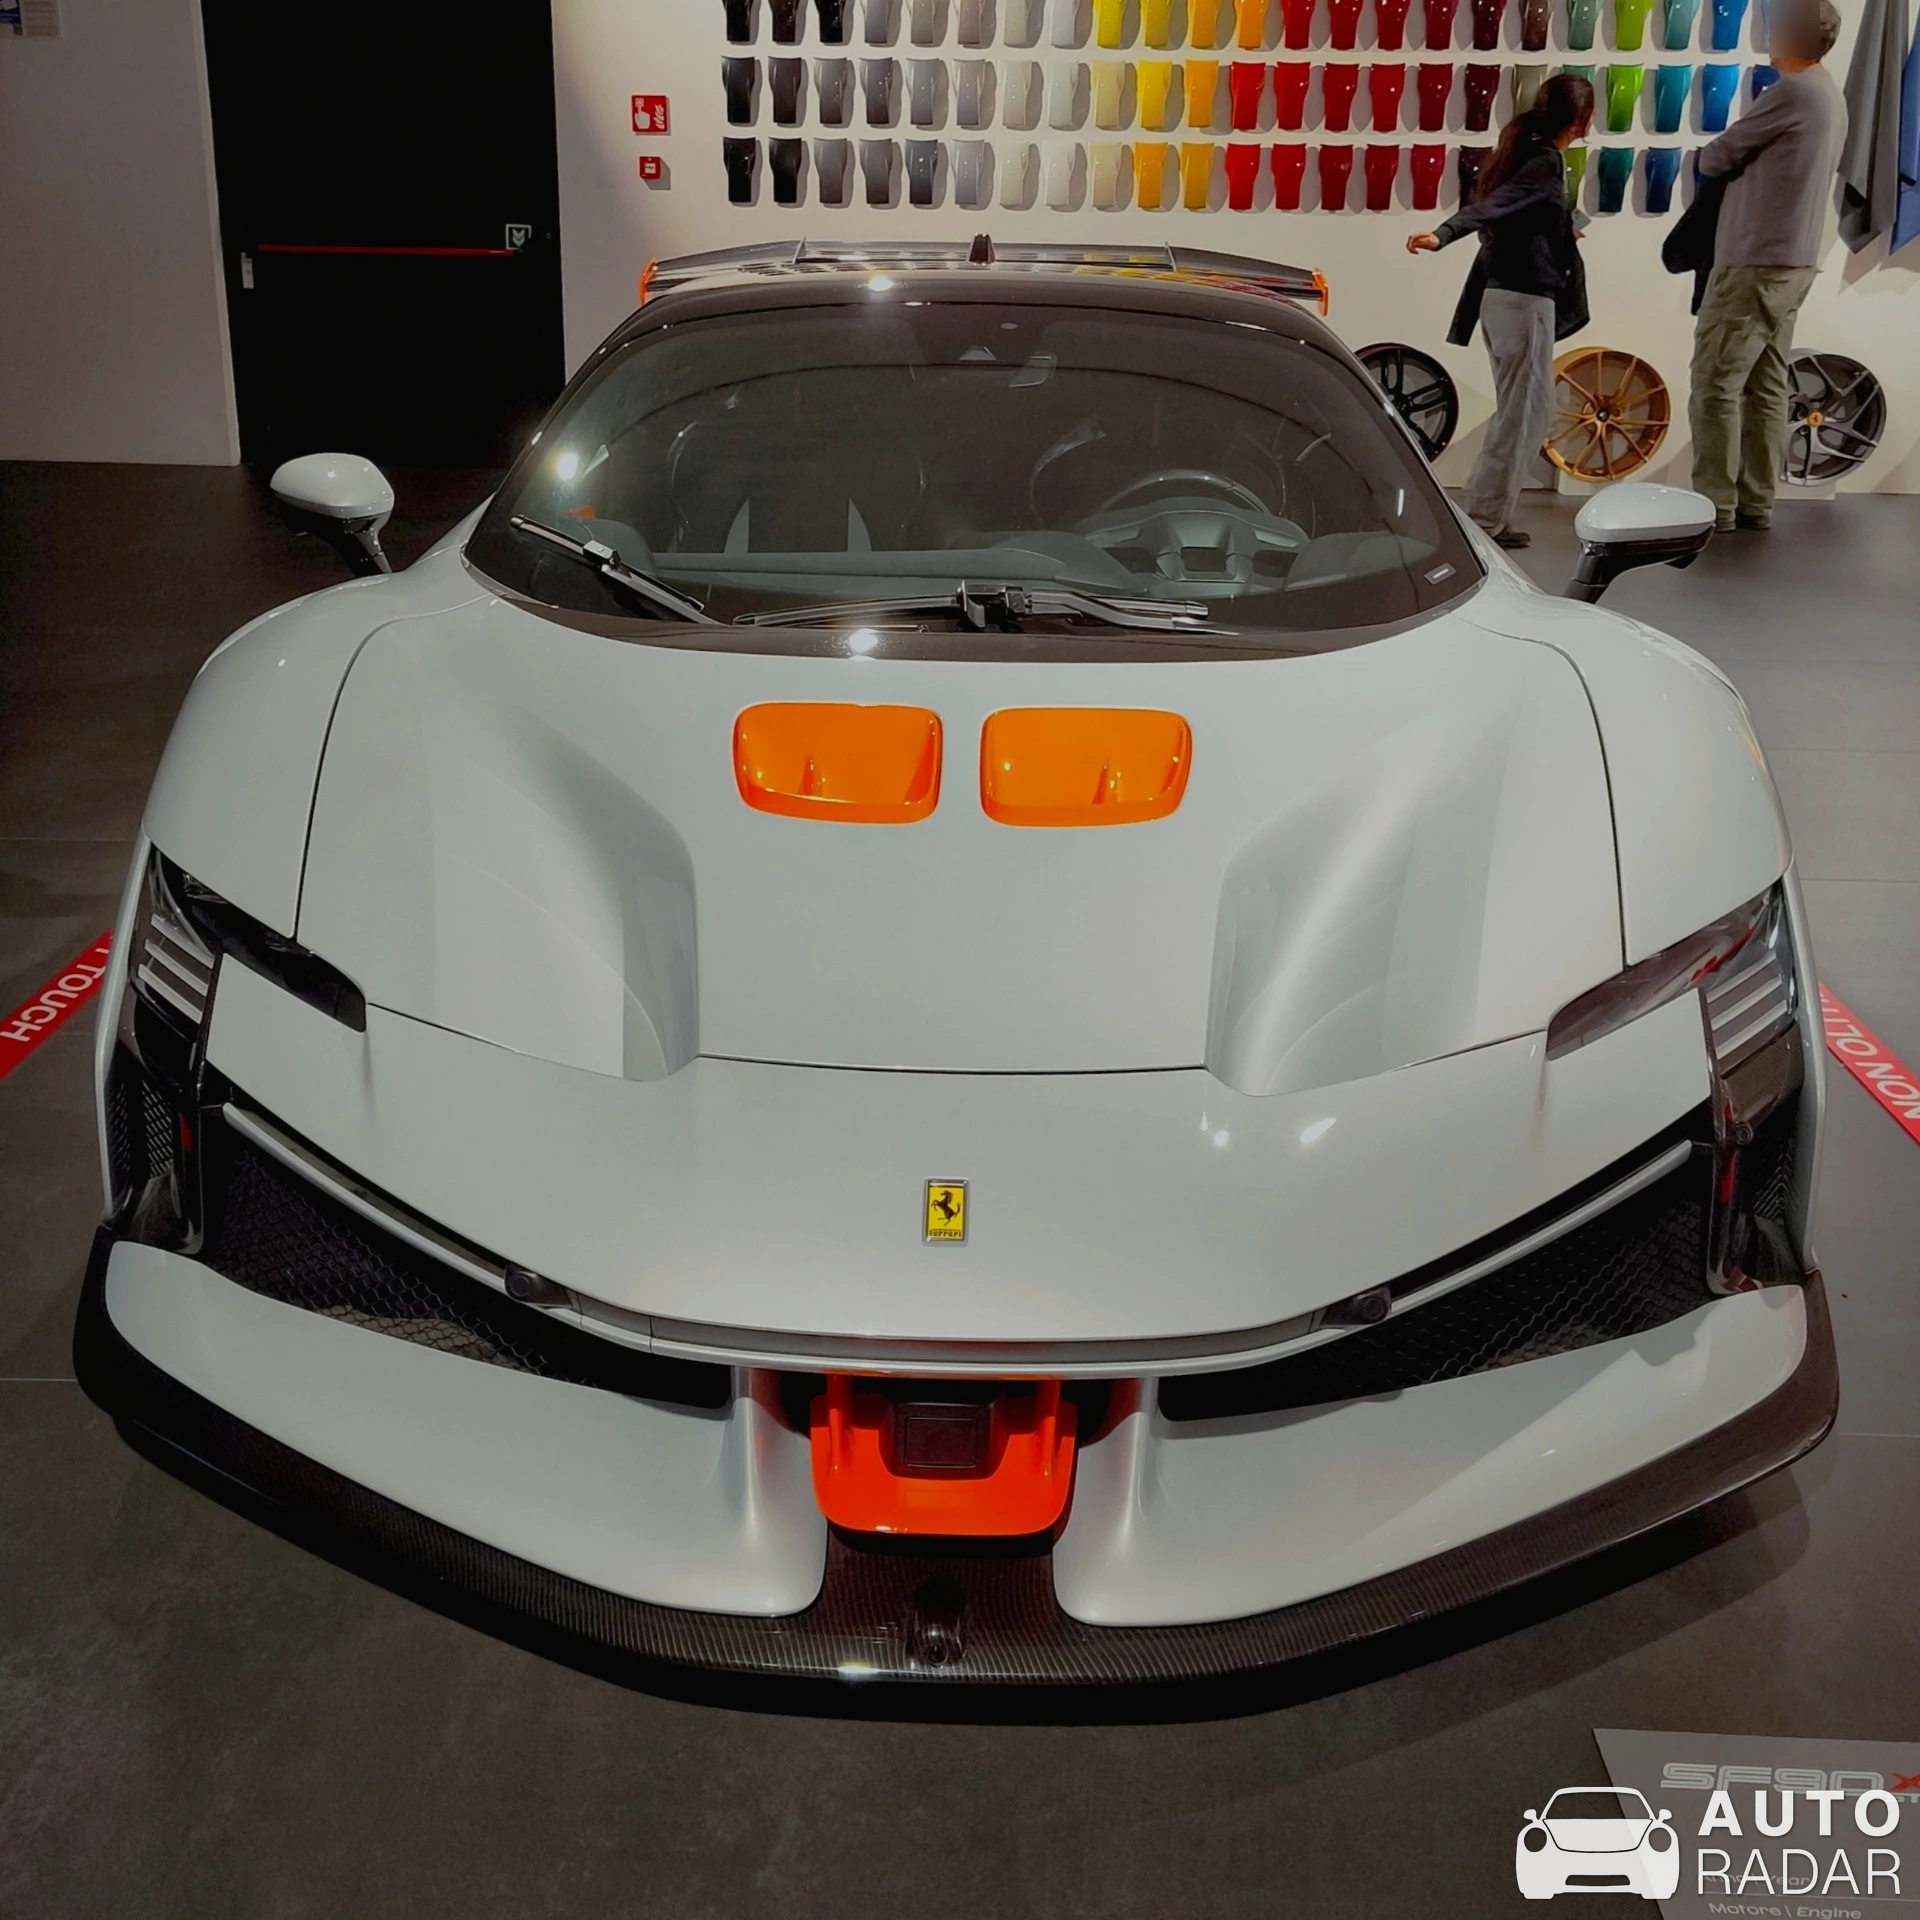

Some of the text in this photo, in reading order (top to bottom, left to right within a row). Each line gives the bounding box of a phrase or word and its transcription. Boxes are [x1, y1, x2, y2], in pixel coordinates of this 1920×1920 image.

[0, 964, 106, 1042] TOUCH
[1661, 1763, 1885, 1797] SF90
[1708, 1902, 1782, 1916] Motore
[1797, 1906, 1862, 1919] Engine
